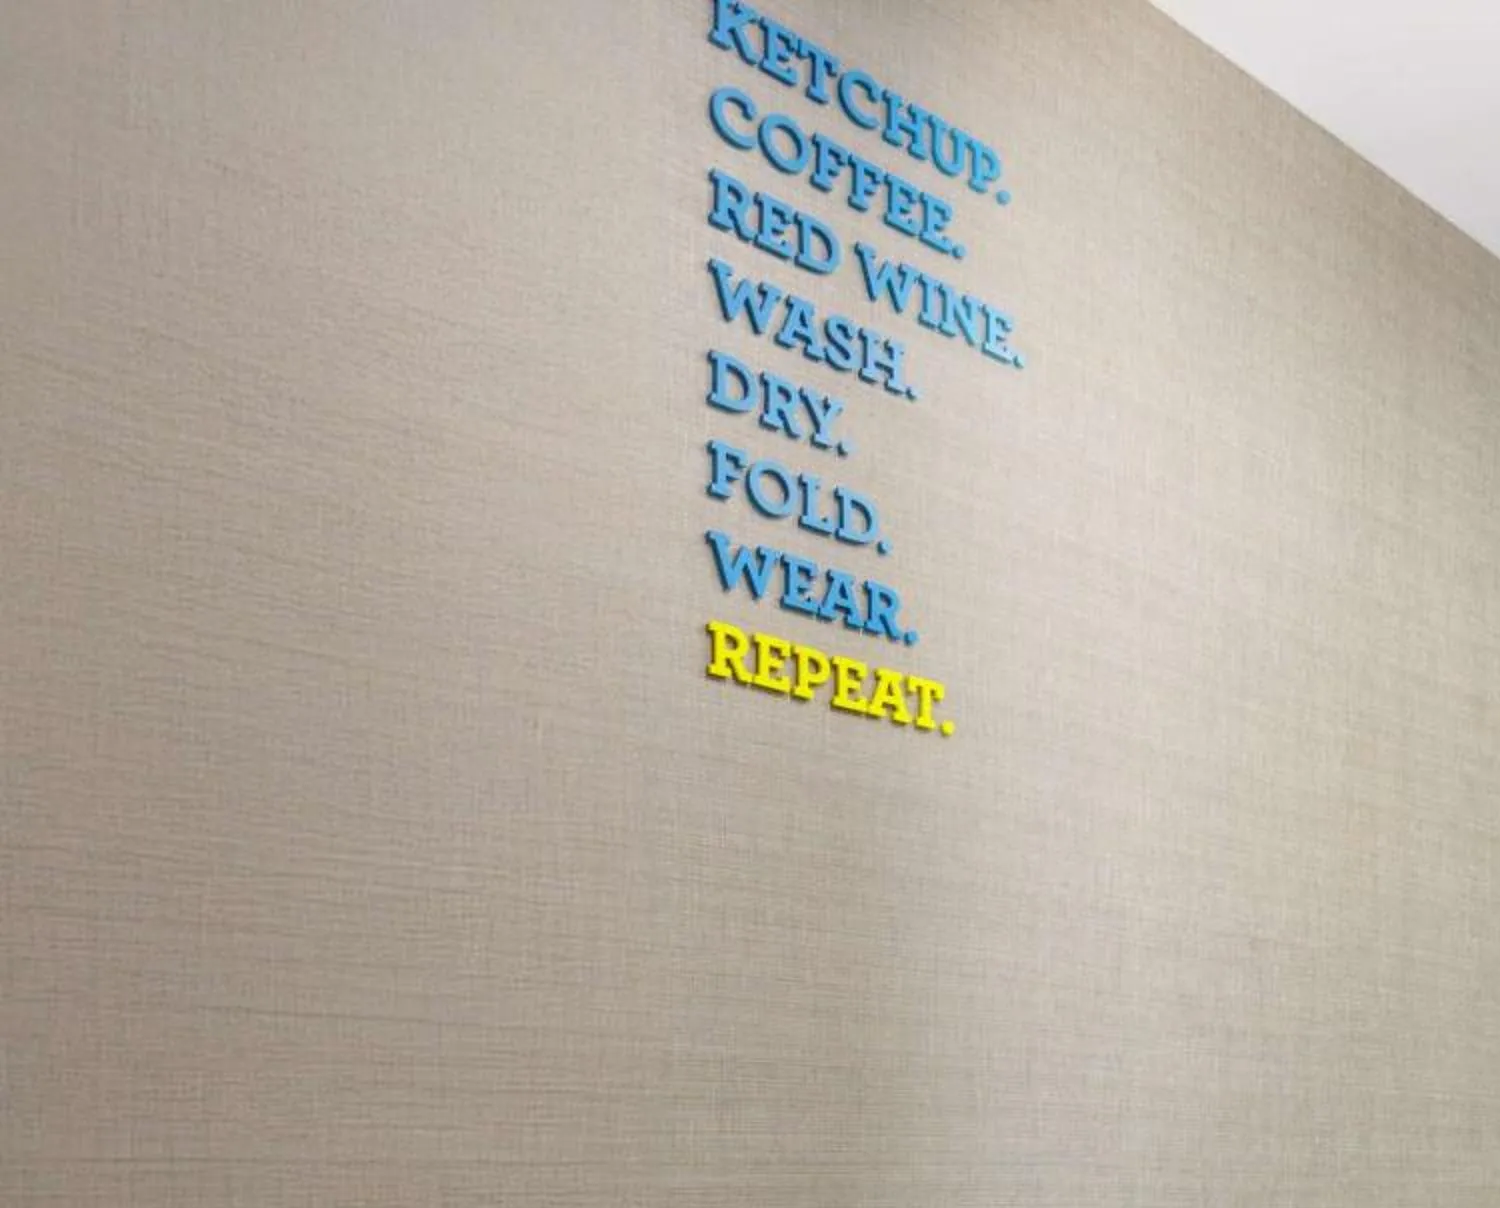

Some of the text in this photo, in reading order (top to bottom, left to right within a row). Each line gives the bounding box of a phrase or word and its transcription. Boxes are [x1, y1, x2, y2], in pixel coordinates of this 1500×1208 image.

[708, 0, 1012, 206] KETCHUP.
[708, 86, 966, 260] COFFEE.
[707, 168, 1026, 369] RED WINE.
[707, 257, 920, 402] WASH.
[706, 350, 853, 456] DRY.
[706, 440, 894, 555] FOLD.
[706, 530, 920, 647] WEAR.
[706, 620, 956, 737] REPEAT.
